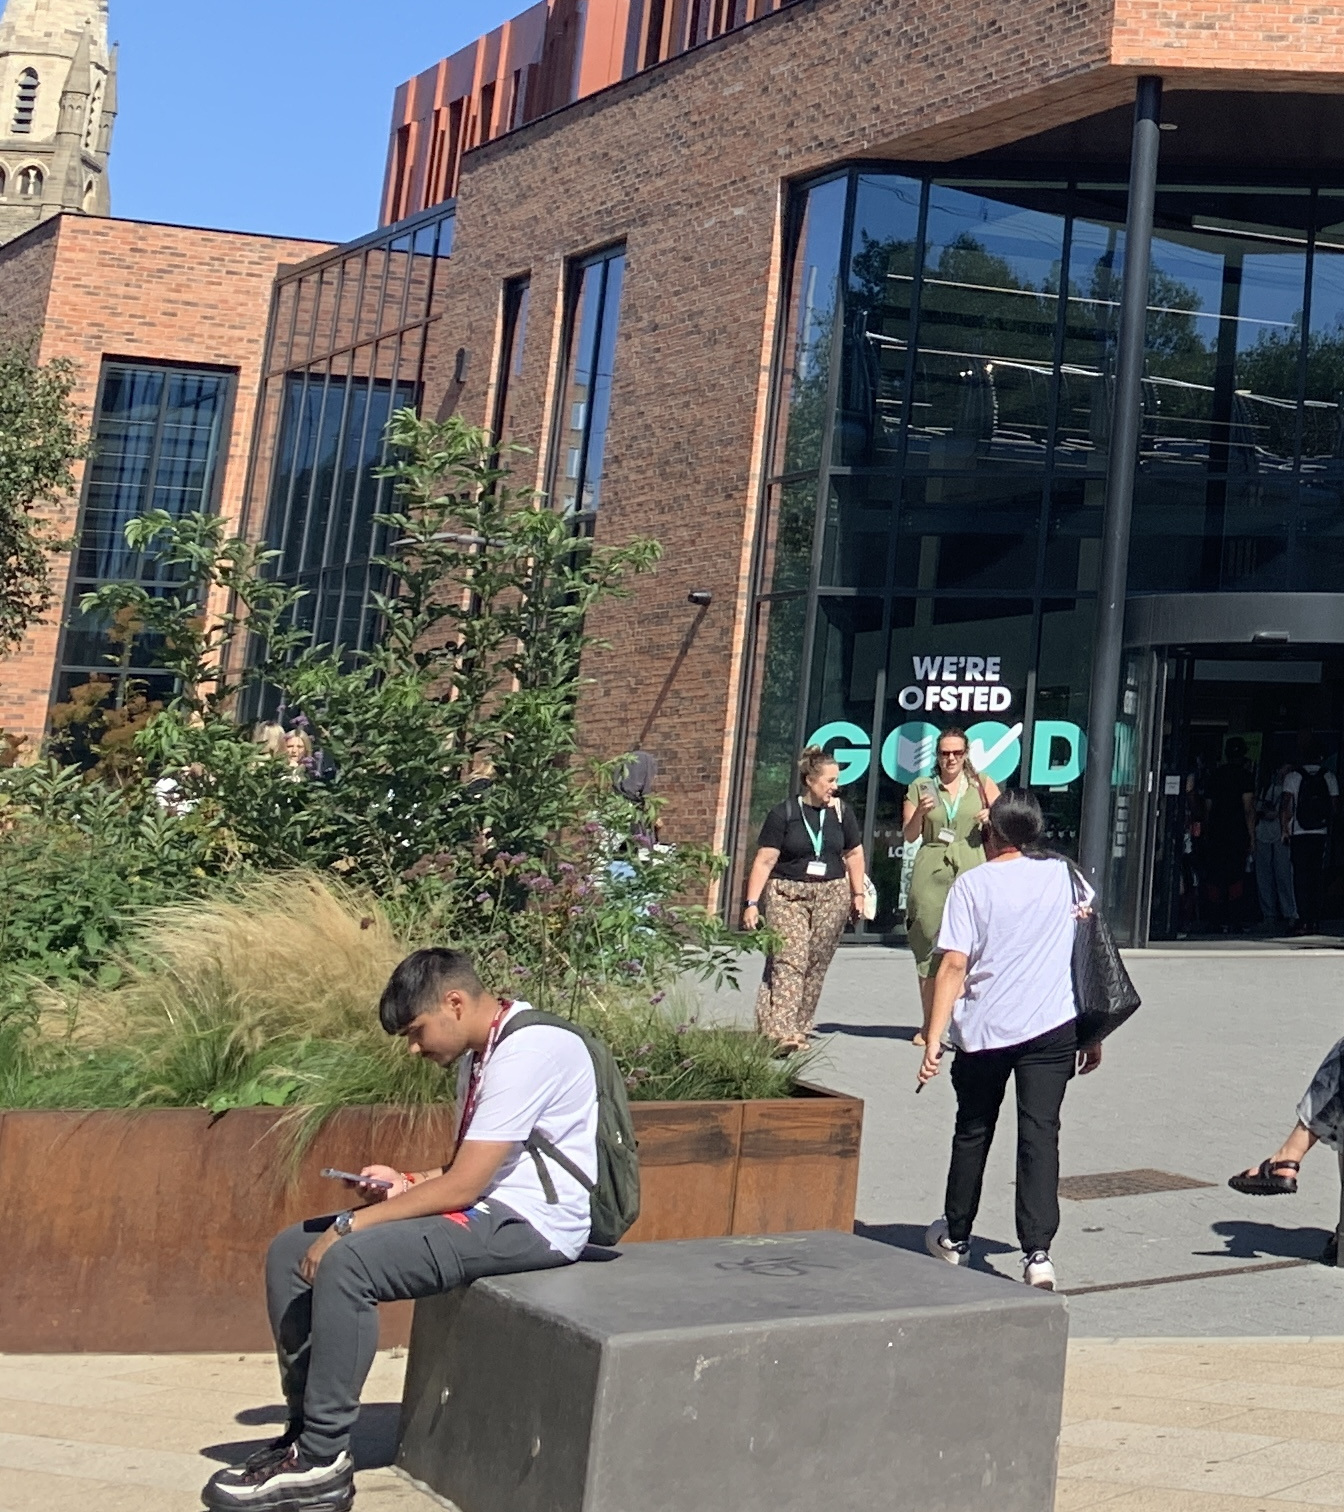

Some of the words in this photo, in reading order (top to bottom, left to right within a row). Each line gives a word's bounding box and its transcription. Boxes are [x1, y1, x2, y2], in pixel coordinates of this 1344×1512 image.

[912, 655, 1001, 682] WE'RE
[898, 685, 1012, 713] OFSTED
[806, 719, 1088, 787] GOOD
